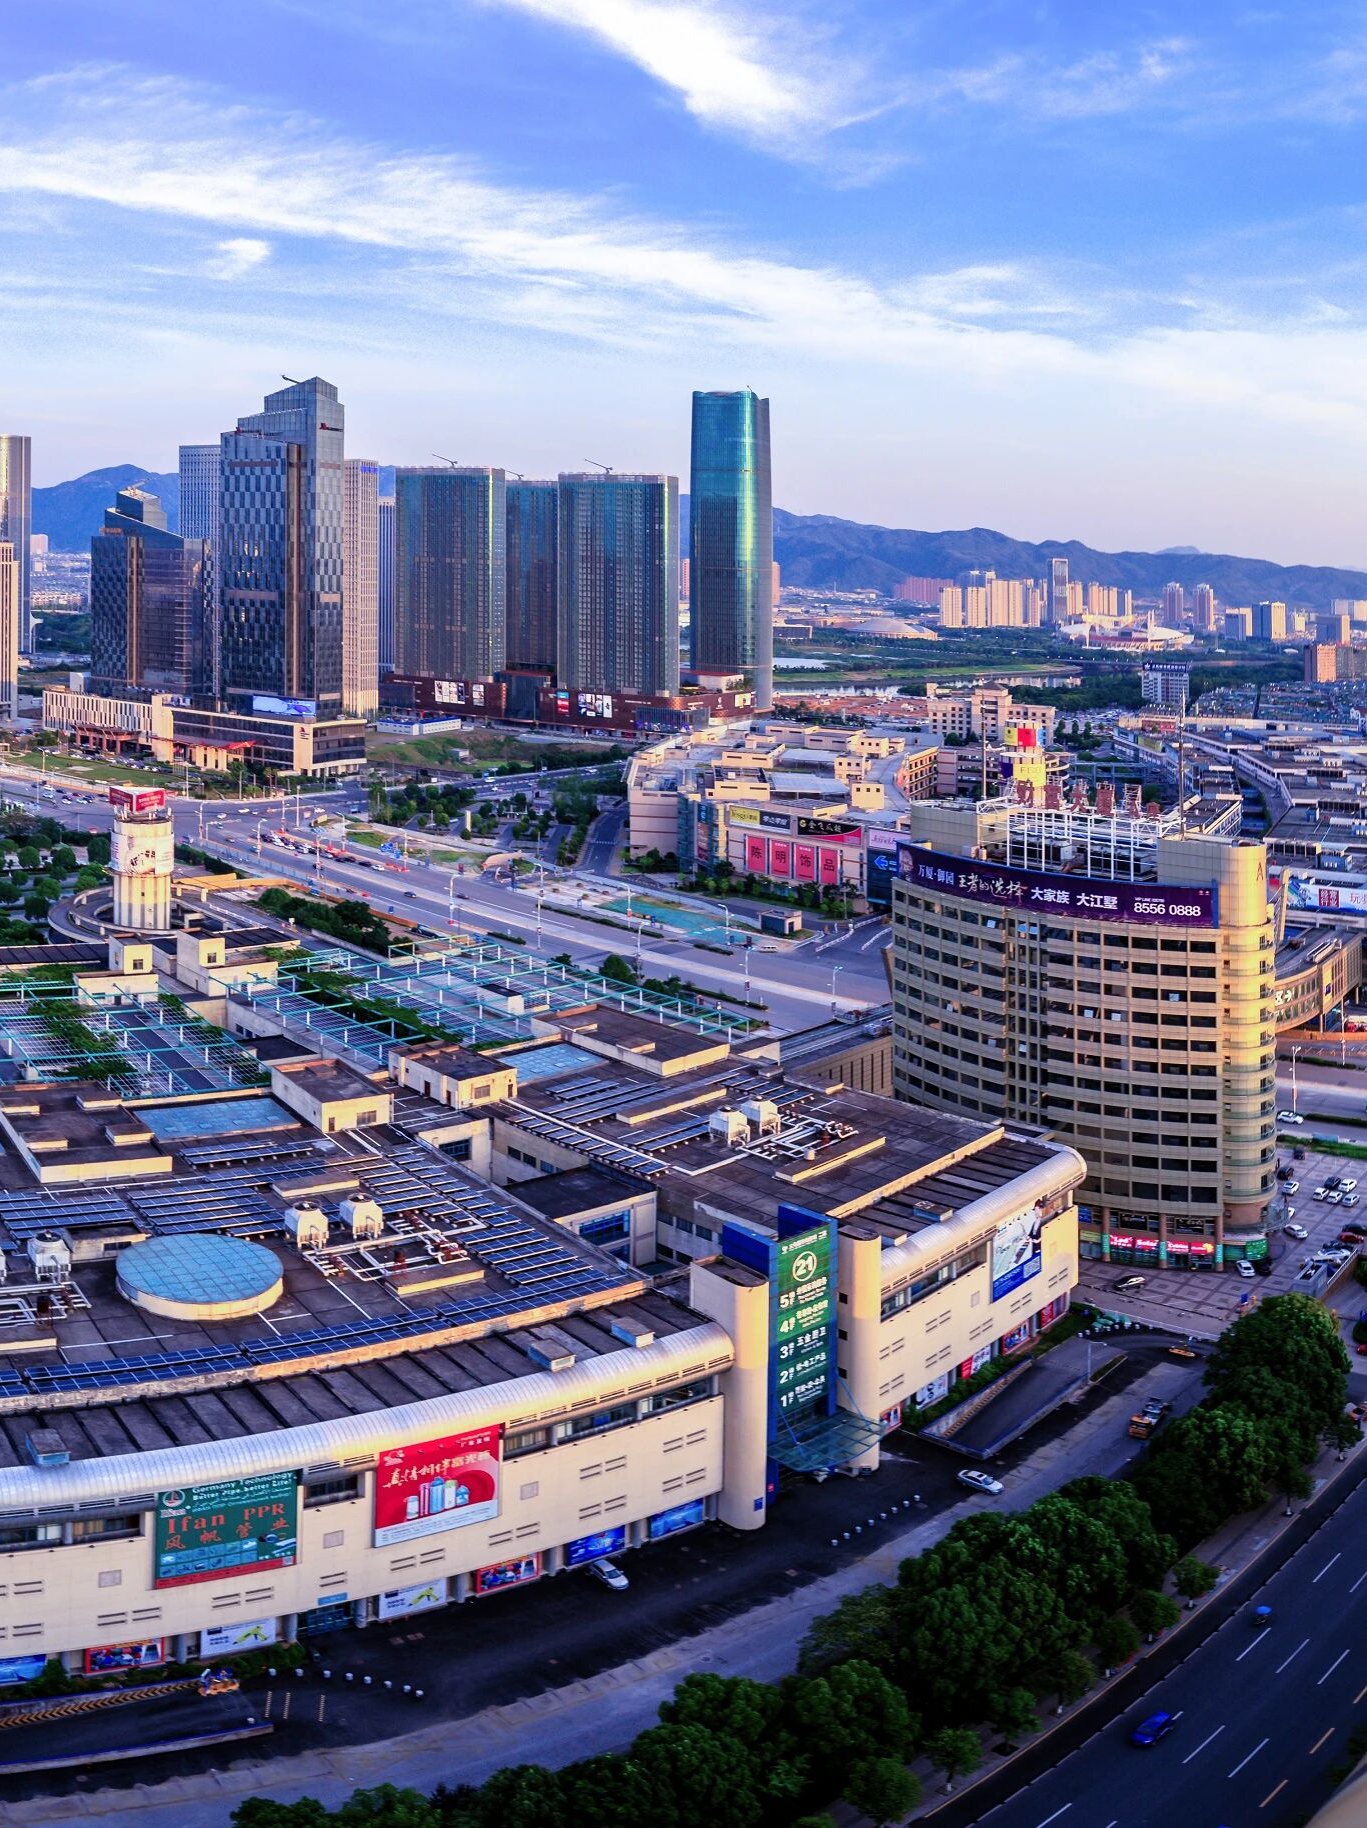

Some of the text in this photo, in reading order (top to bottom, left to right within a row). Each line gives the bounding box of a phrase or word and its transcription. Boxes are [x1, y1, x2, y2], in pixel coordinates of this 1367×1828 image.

[1256, 861, 1264, 881] A
[1031, 886, 1071, 904] 大家族
[1076, 892, 1119, 910] 大江墅
[1133, 902, 1202, 917] 8556 0888
[795, 1255, 813, 1276] 21
[192, 1480, 236, 1494] Germany
[168, 1503, 285, 1534] Ifan PPR
